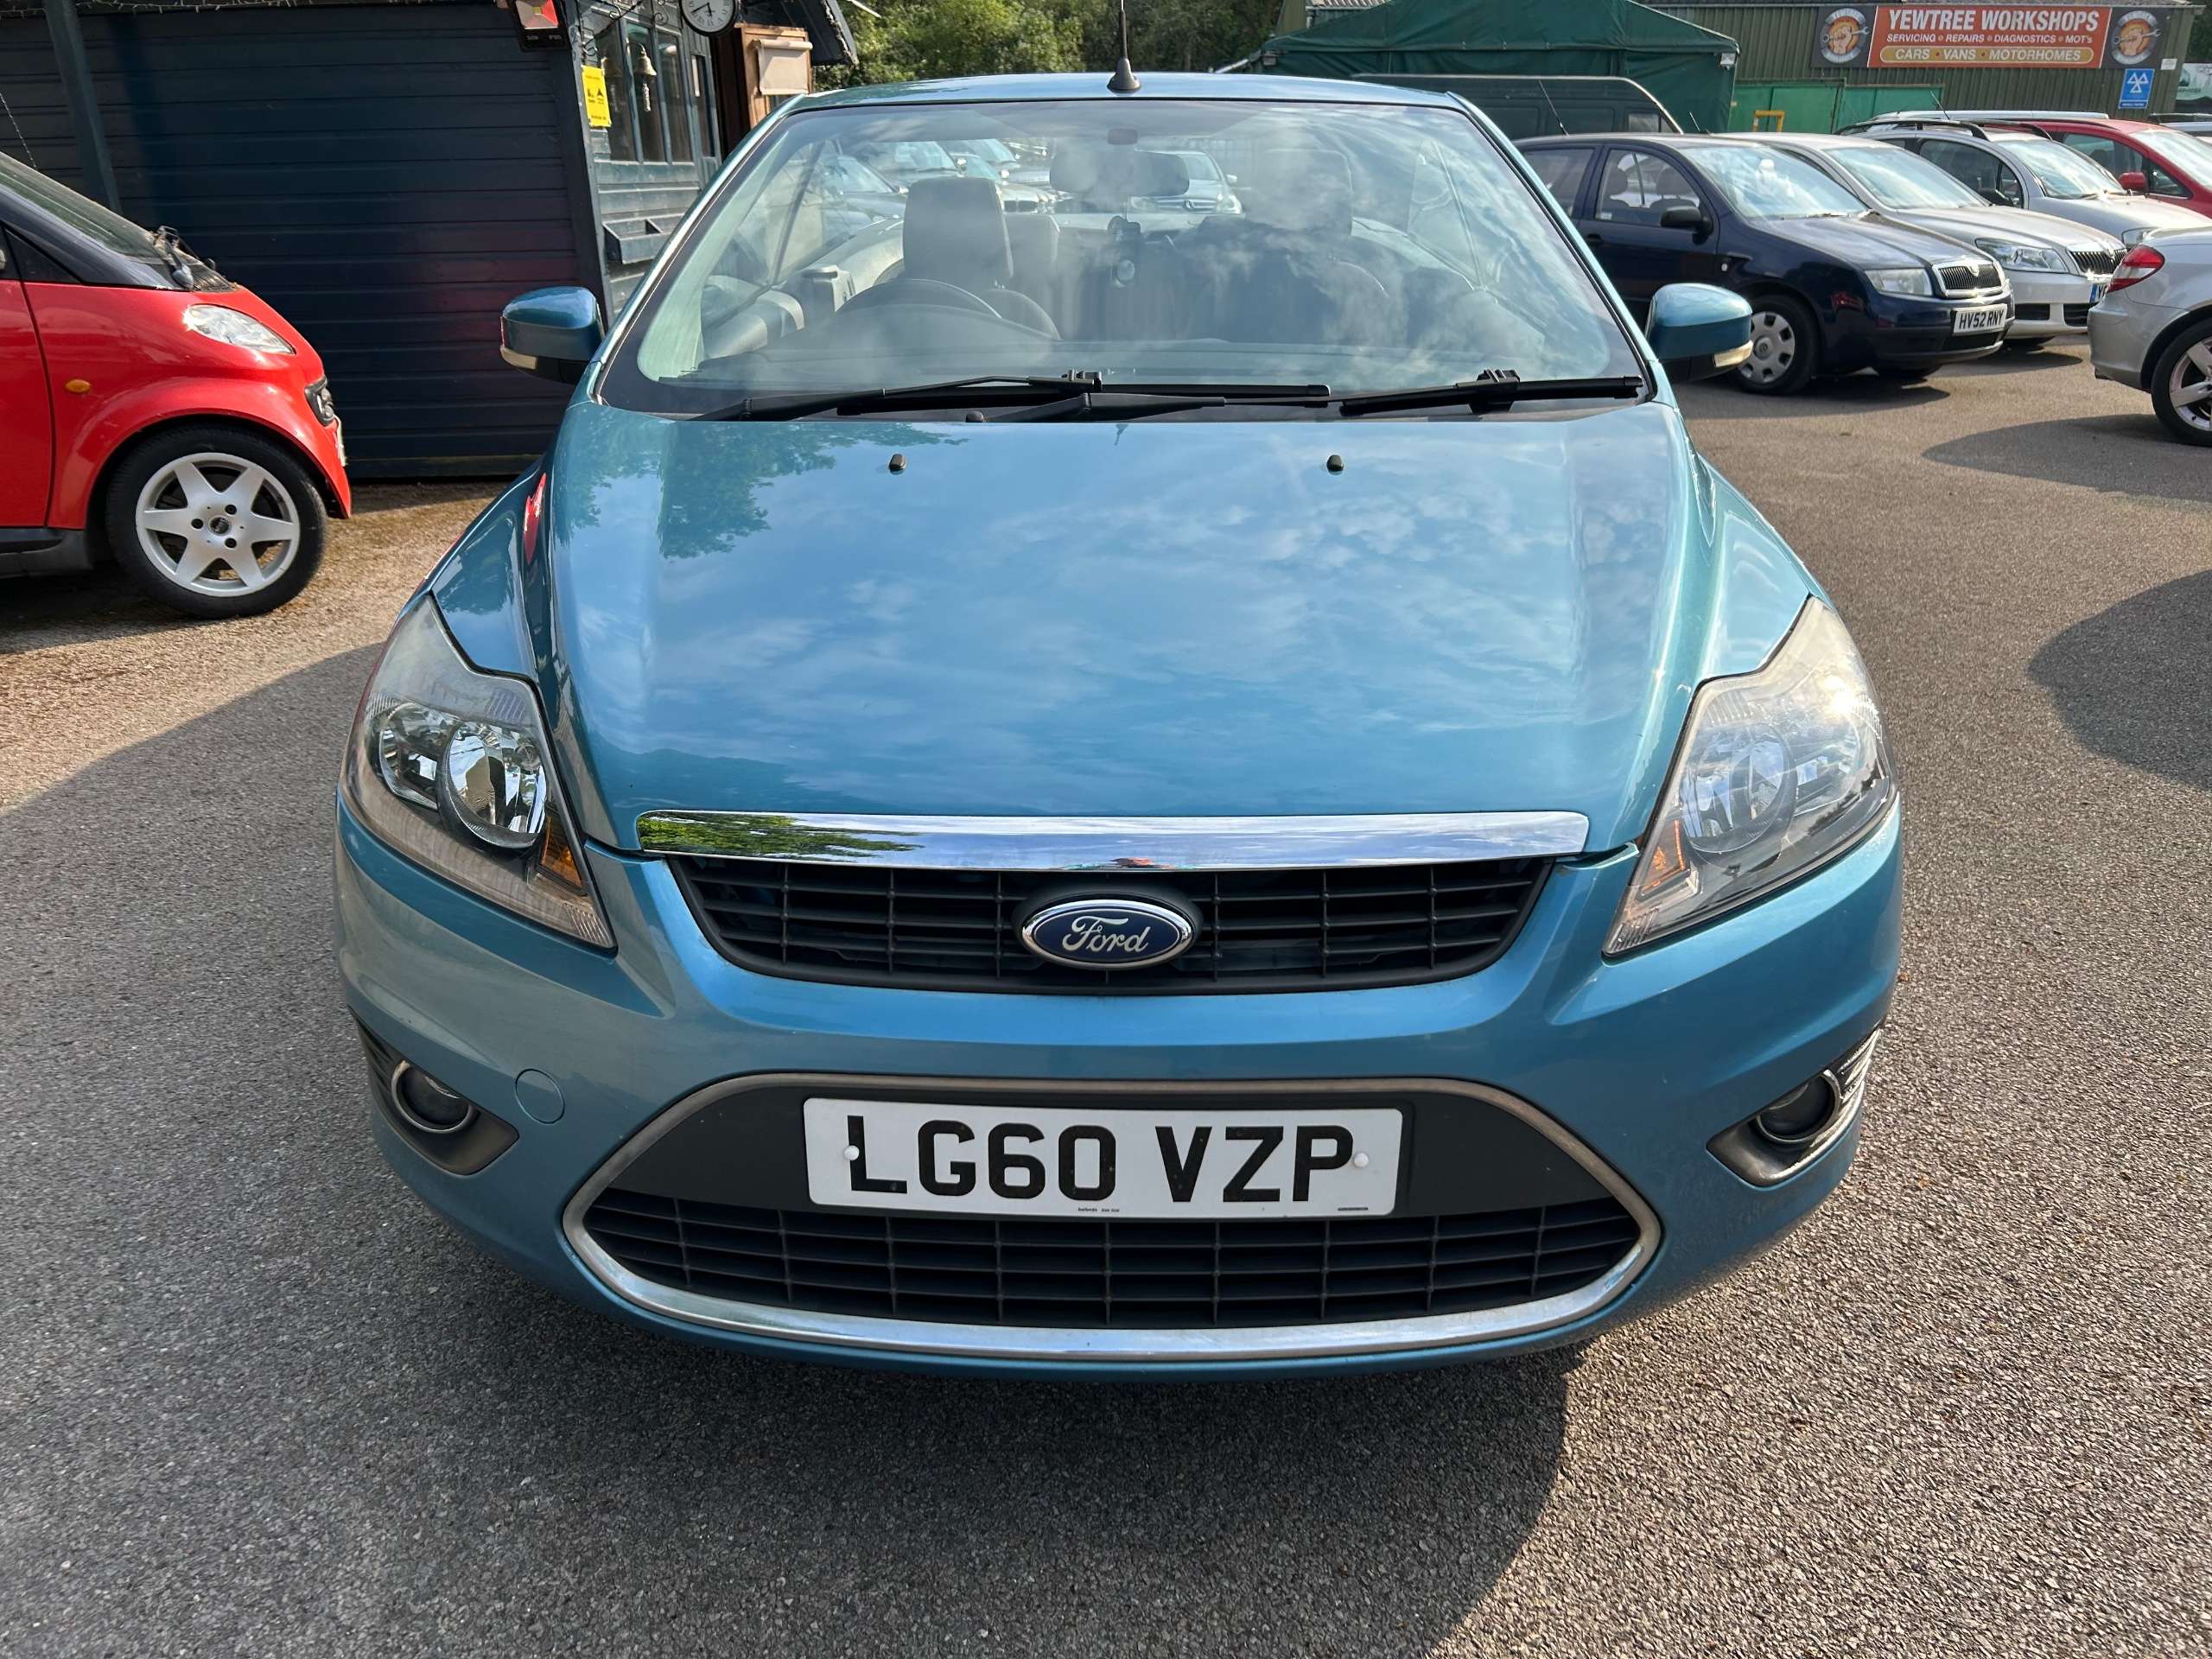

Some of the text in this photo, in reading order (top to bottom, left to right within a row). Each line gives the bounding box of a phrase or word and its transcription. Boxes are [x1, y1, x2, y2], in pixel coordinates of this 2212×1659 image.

[1889, 9, 1976, 30] YEWTREE
[1981, 10, 2100, 32] WORKSHOPS
[1886, 34, 1936, 42] SERVICING
[1945, 34, 1985, 42] REPAIRS
[1993, 34, 2056, 43] DIAGNOSTICS
[1895, 48, 2082, 60] CARS VANS MOTORHOMES
[1959, 308, 2005, 329] HV52 RNY
[1062, 914, 1152, 953] Ford
[847, 1114, 1355, 1204] LG60 VZP
